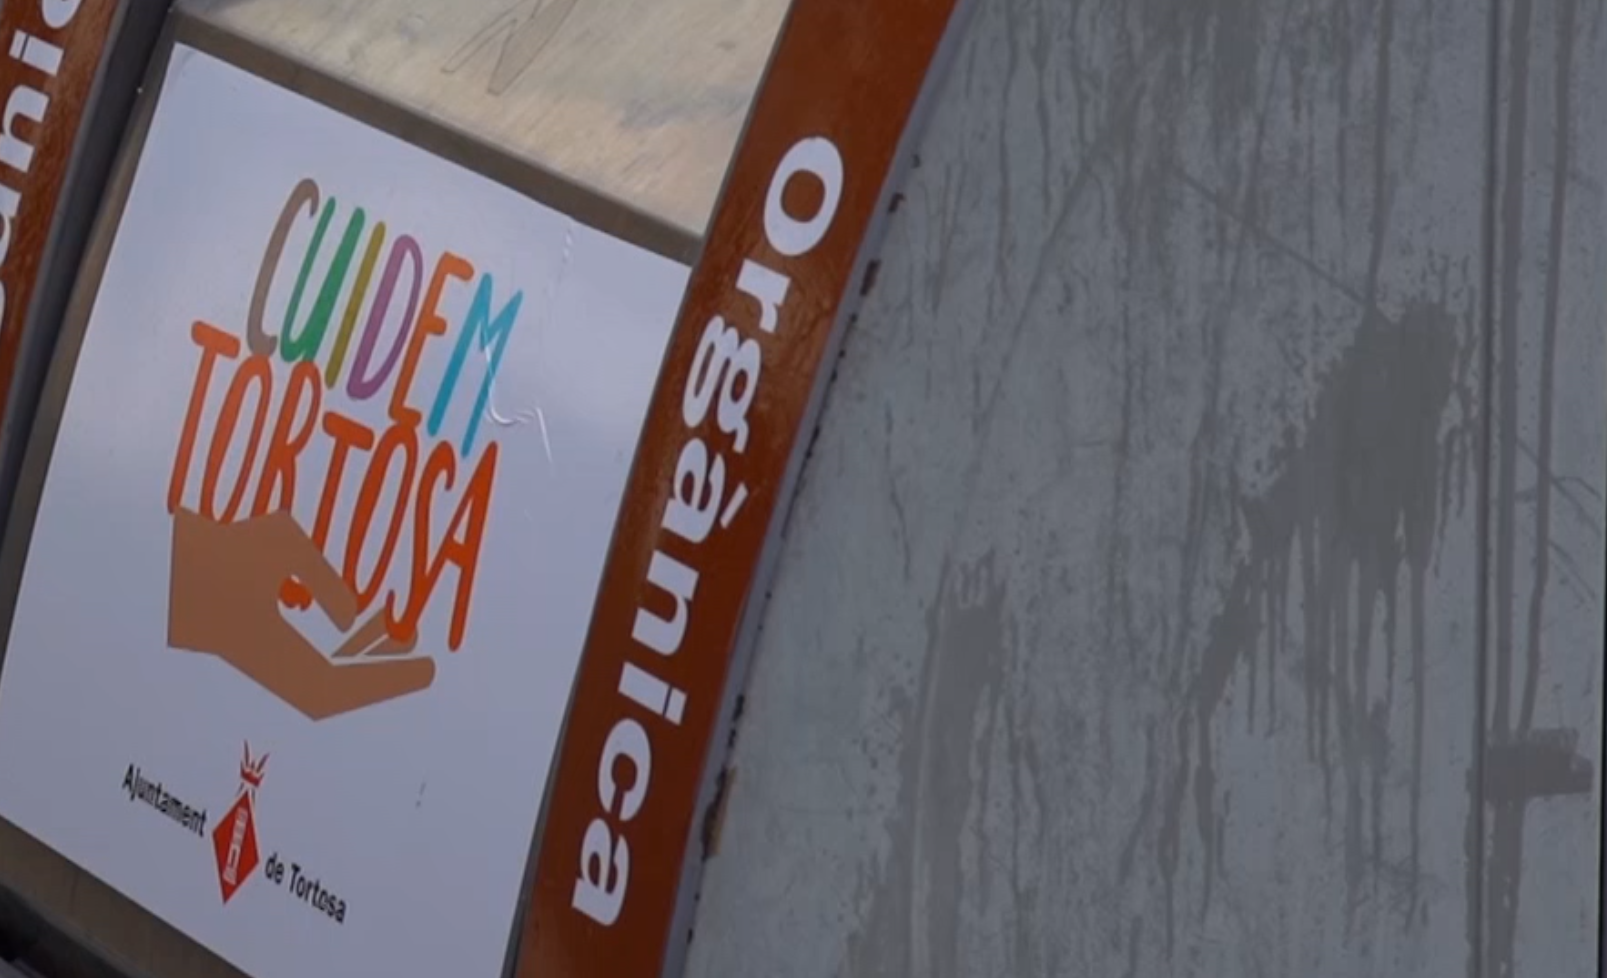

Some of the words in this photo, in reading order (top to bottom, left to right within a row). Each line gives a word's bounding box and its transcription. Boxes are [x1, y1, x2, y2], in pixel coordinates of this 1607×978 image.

[246, 177, 524, 459] CUIDEM
[166, 319, 498, 653] TORTOSA
[571, 135, 844, 928] Orgànica
[121, 763, 207, 837] Ajuntament
[264, 852, 285, 885] de
[288, 863, 347, 924] Tortosa
